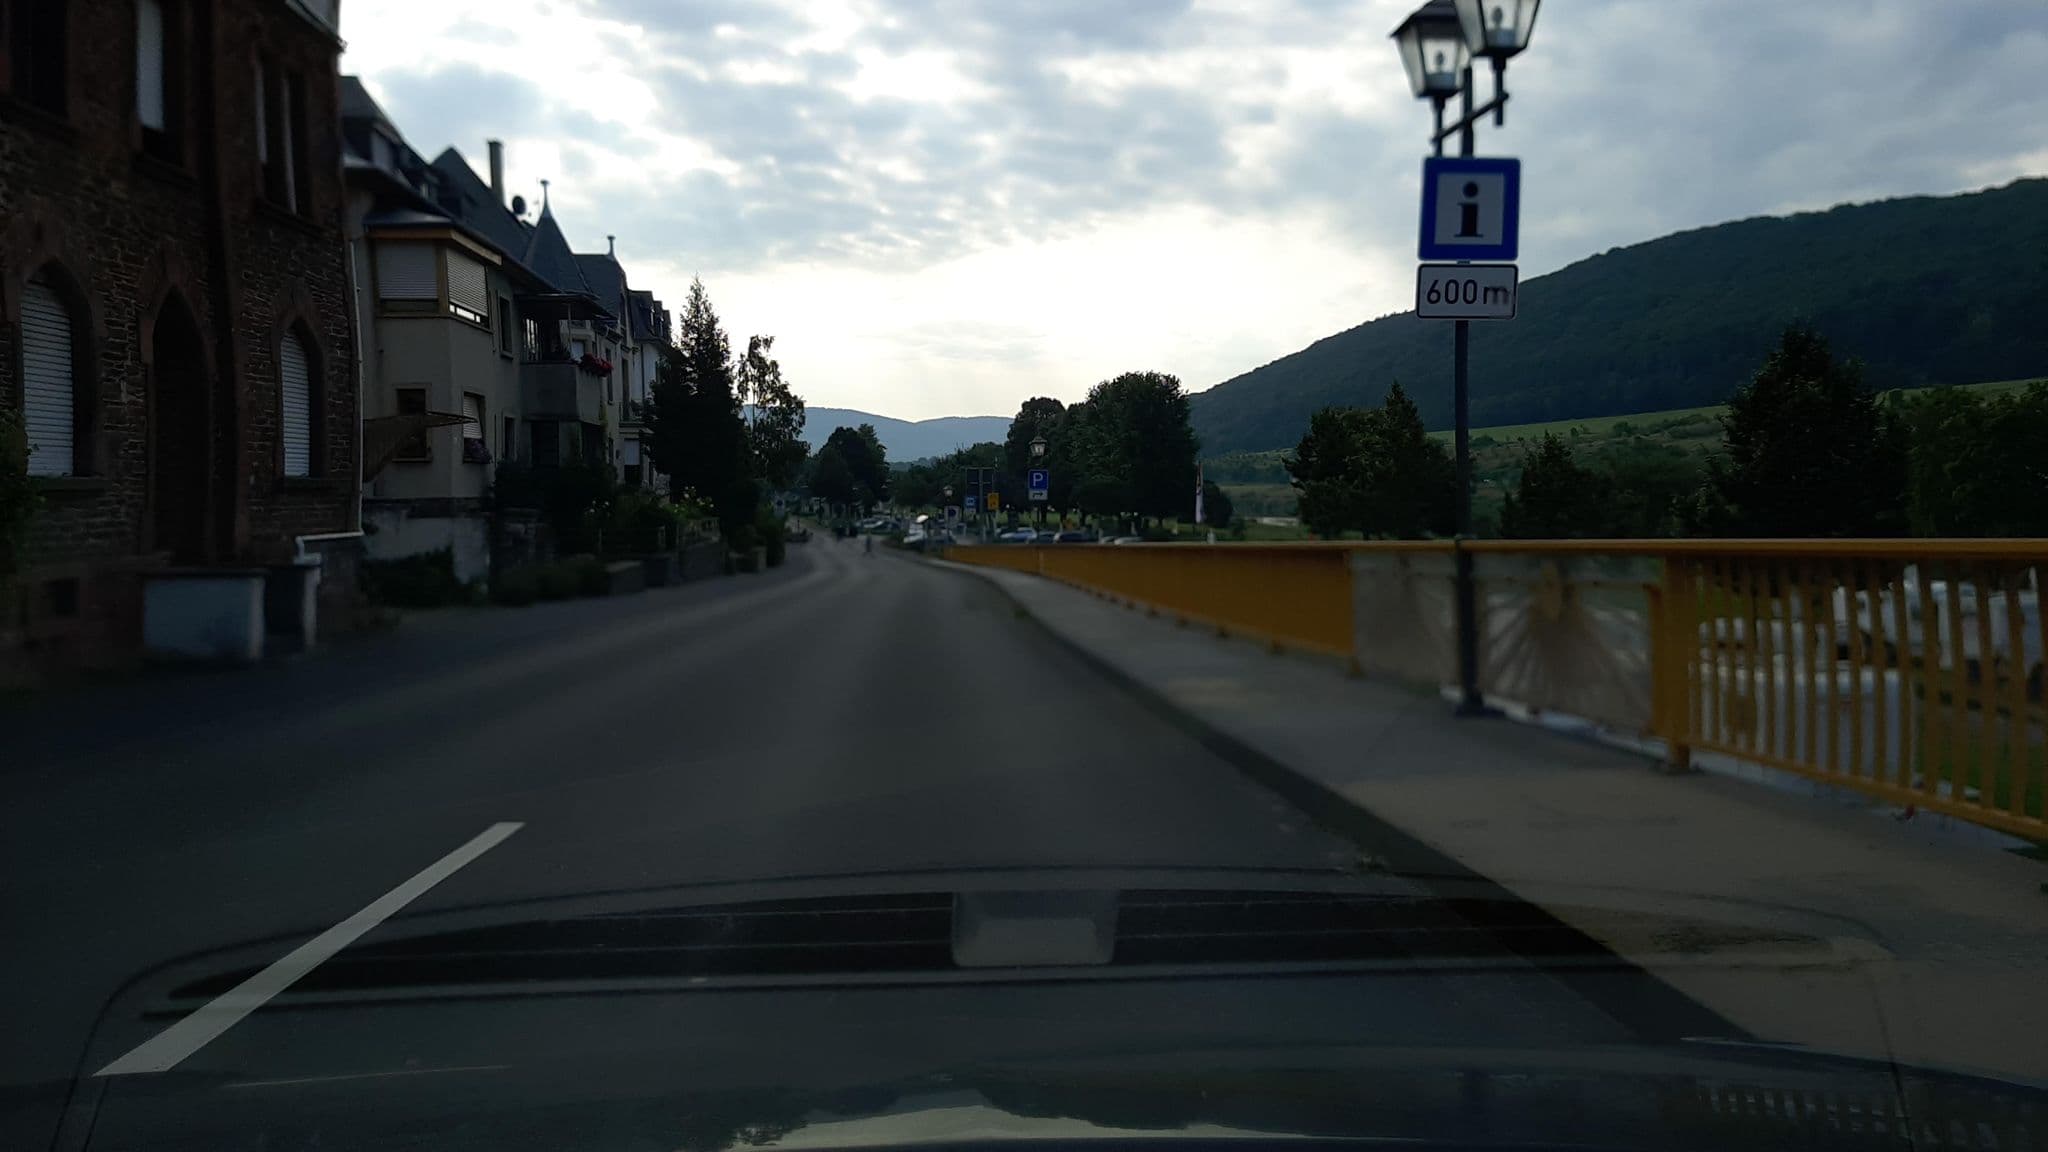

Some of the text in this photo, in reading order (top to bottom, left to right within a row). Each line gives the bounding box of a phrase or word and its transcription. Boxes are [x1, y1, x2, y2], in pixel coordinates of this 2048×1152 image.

[1427, 279, 1511, 305] 600 m
[1032, 472, 1043, 487] P
